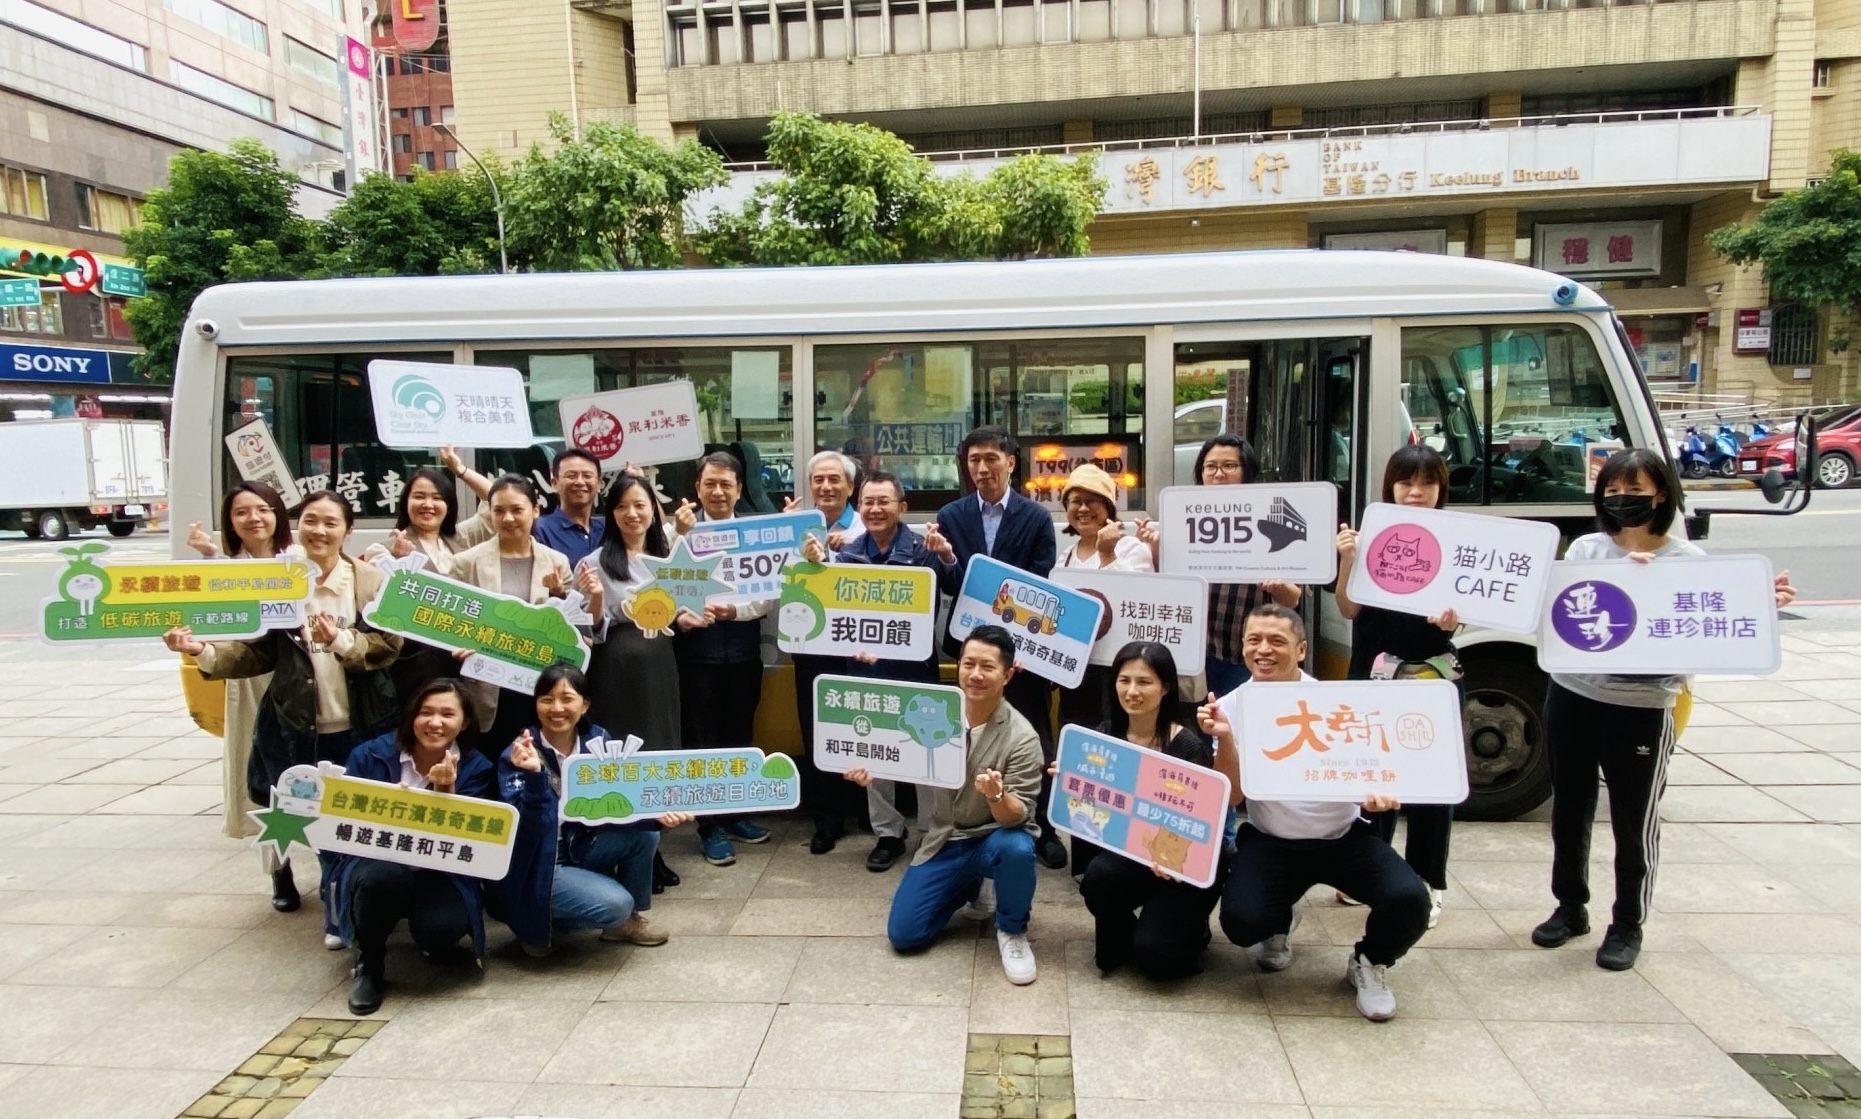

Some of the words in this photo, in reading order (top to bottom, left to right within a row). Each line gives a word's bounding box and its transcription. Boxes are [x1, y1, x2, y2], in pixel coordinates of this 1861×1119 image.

[1323, 141, 1363, 152] BANK
[1323, 153, 1341, 163] OF
[1323, 161, 1380, 174] TAIWAN
[1429, 171, 1504, 188] Keelung
[1512, 166, 1580, 183] Branch
[1322, 171, 1417, 196] 基隆分行
[13, 353, 91, 374] SONY
[455, 394, 515, 409] 天晴晴天
[458, 410, 517, 424] 複合美食
[743, 525, 795, 547] 享回饋
[1186, 516, 1253, 544] 1915
[739, 552, 789, 579] 50%
[119, 575, 202, 594] 永續旅遊
[208, 578, 293, 592] 從和平島開始
[834, 576, 914, 606] 你減碳
[1455, 575, 1519, 603] CAFE
[261, 602, 295, 616] PATA
[398, 578, 484, 619] 共同打造
[1673, 591, 1727, 613] 基隆
[57, 616, 88, 631] 打造
[99, 612, 184, 629] 低碳旅遊
[191, 613, 249, 626] 示範路線
[1120, 600, 1193, 624] 找到幸福
[411, 605, 555, 664] 國際永續旅遊島
[831, 616, 912, 647] 我回饋
[1127, 622, 1182, 645] 咖啡店
[1647, 616, 1757, 639] 連珍餅店
[825, 688, 901, 714] 永續旅遊
[855, 720, 871, 734] 從
[825, 739, 900, 763] 和平島開始
[1319, 758, 1350, 767] Since
[640, 781, 789, 807] 永續旅遊目的地
[331, 790, 505, 837] 台灣好行濱海奇基線
[1136, 801, 1205, 839] 最少75折起
[335, 822, 474, 863] 暢遊基隆和平島
